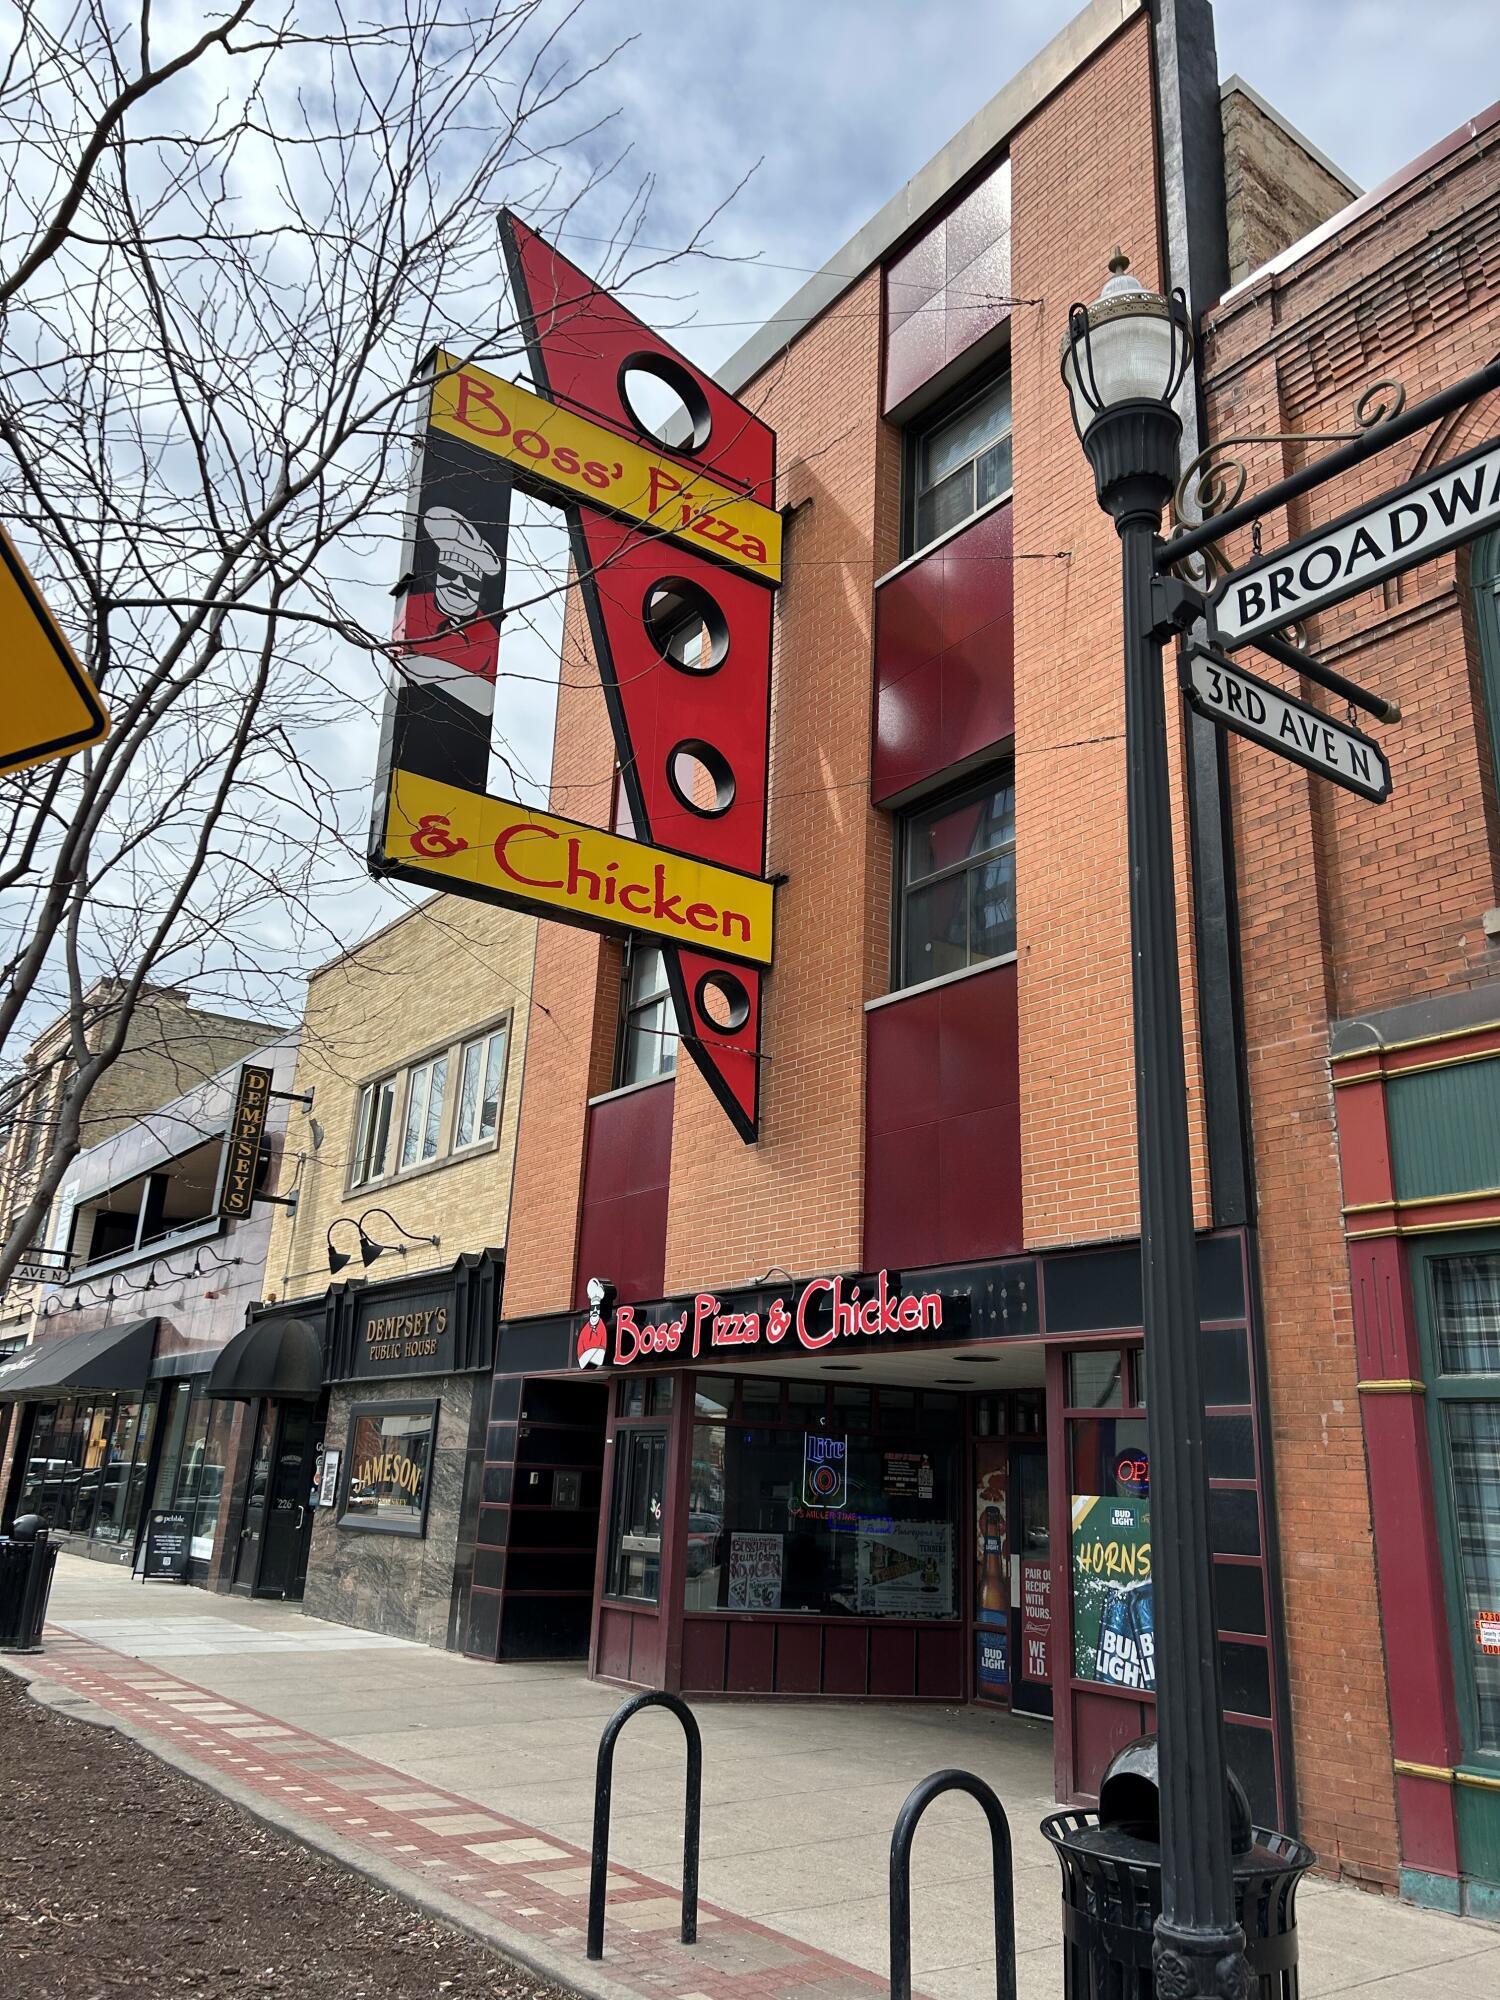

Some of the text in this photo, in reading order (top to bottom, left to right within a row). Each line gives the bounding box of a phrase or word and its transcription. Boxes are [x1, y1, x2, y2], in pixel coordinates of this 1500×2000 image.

[646, 466, 768, 564] Pizza
[1237, 462, 1500, 626] BROADW
[1206, 666, 1371, 782] 3RD AVE N
[410, 814, 752, 943] & Chicken
[229, 1075, 265, 1208] DEMPSEYS
[20, 1266, 62, 1280] AVE N
[692, 1293, 760, 1358] Pizza
[766, 1299, 791, 1344] &
[796, 1269, 943, 1350] Chicken
[366, 1307, 448, 1343] DEMPSEY'S
[369, 1338, 437, 1361] PUBLIC HOUSE
[807, 1436, 845, 1464] Lite
[353, 1453, 421, 1497] JAMESON
[806, 1509, 834, 1520] MILLER
[836, 1512, 857, 1521] TIME
[1112, 1516, 1134, 1526] LIGHT
[1114, 1509, 1131, 1518] BUD
[985, 1543, 999, 1551] LIGHT
[987, 1538, 998, 1546] BUD
[1077, 1542, 1151, 1577] HORNS
[1025, 1567, 1041, 1580] PAIR
[1025, 1580, 1050, 1594] RECIPE
[1025, 1593, 1044, 1606] WITH
[1025, 1606, 1052, 1620] YOURS.
[983, 1647, 1003, 1660] BUD
[1028, 1639, 1046, 1659] WE
[981, 1656, 1005, 1670] LIGHT
[1028, 1657, 1048, 1677] I.D.
